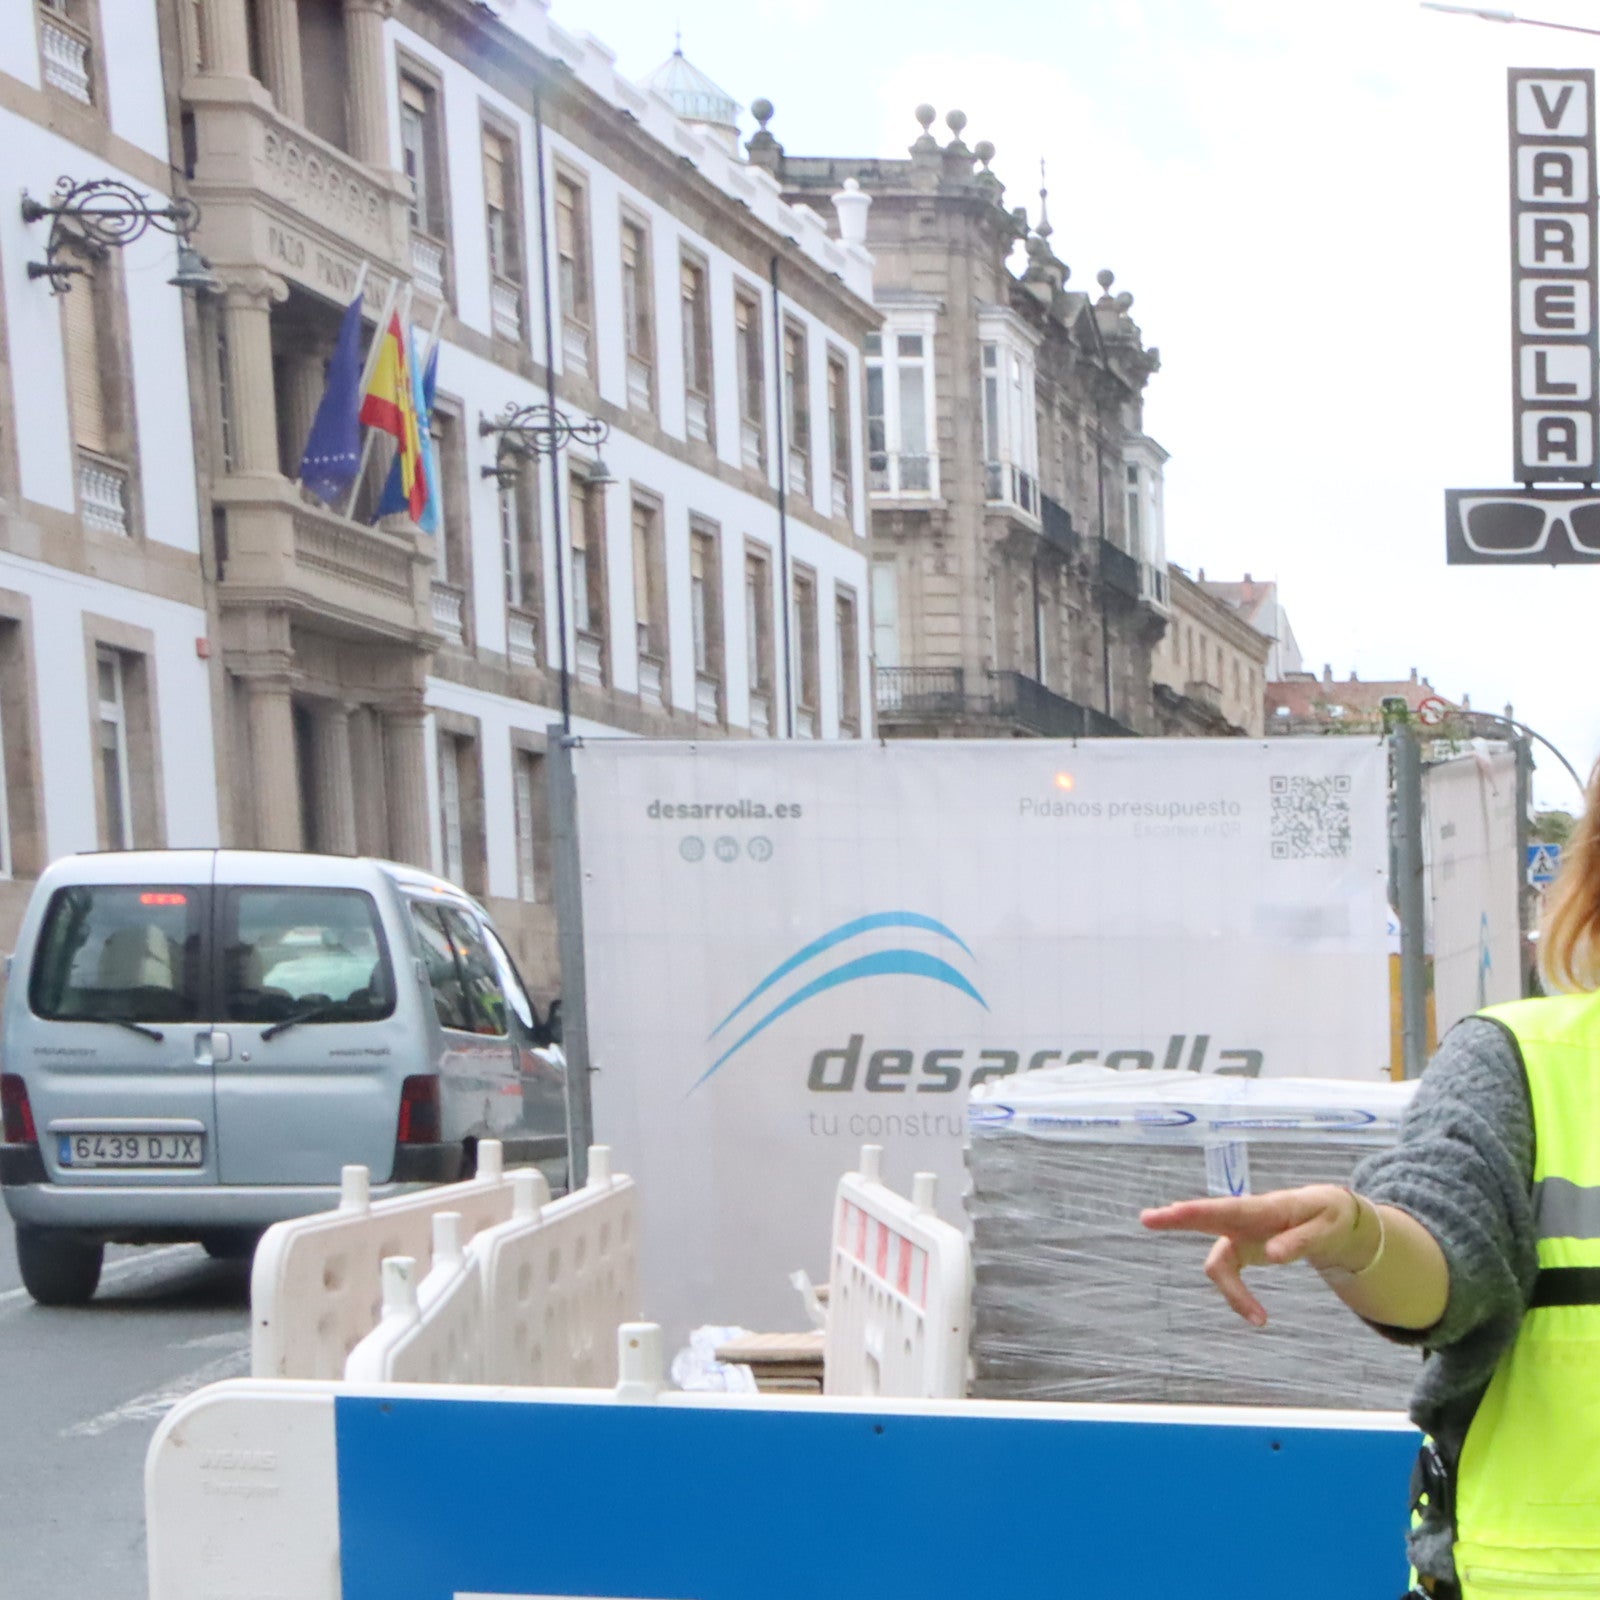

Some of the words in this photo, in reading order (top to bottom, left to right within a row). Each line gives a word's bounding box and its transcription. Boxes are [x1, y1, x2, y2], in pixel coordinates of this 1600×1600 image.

[1531, 85, 1578, 462] VARELA
[647, 800, 802, 819] desarrolla.es
[1108, 799, 1241, 825] presupuesto
[808, 1112, 839, 1137] tu
[76, 1137, 139, 1159] 6439
[148, 1137, 194, 1159] DJX
